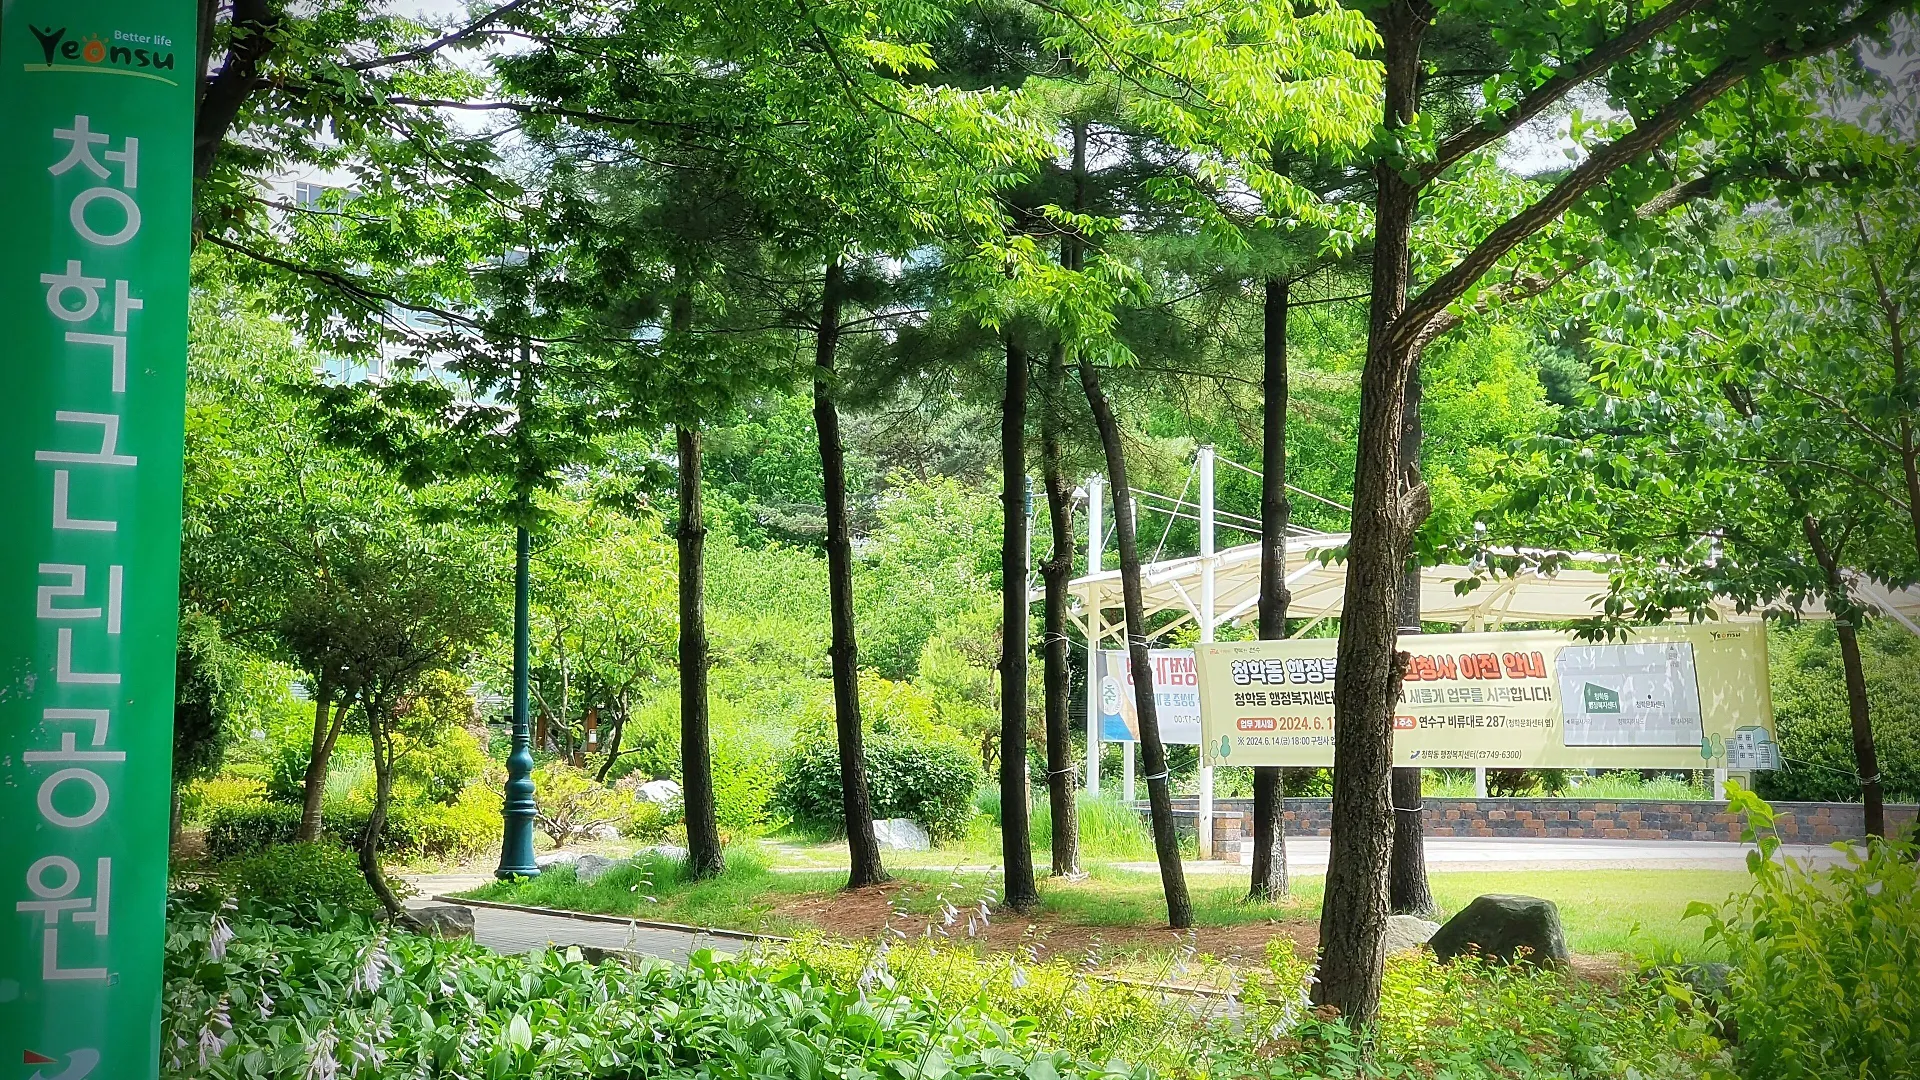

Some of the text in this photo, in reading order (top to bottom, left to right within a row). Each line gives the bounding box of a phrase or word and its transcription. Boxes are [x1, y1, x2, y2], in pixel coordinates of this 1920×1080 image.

[28, 24, 175, 70] Yeonsu
[114, 30, 172, 47] Better life
[16, 115, 144, 982] 청학근린공원
[1231, 659, 1285, 685] 청학동
[1459, 652, 1502, 680] 이전
[1503, 651, 1548, 679] 안내
[1234, 691, 1267, 706] 청학동
[1410, 687, 1445, 704] 새롭게
[1447, 687, 1483, 703] 업무를
[1487, 686, 1552, 702] 시작합니다!
[1240, 719, 1254, 729] 업무
[1279, 716, 1336, 731] 2024.6.1
[1399, 717, 1413, 727] 주소
[1418, 715, 1446, 729] 연수구
[1447, 715, 1484, 729] 비류대로
[1311, 736, 1329, 746] 구청사
[1421, 750, 1440, 760] 청학동
